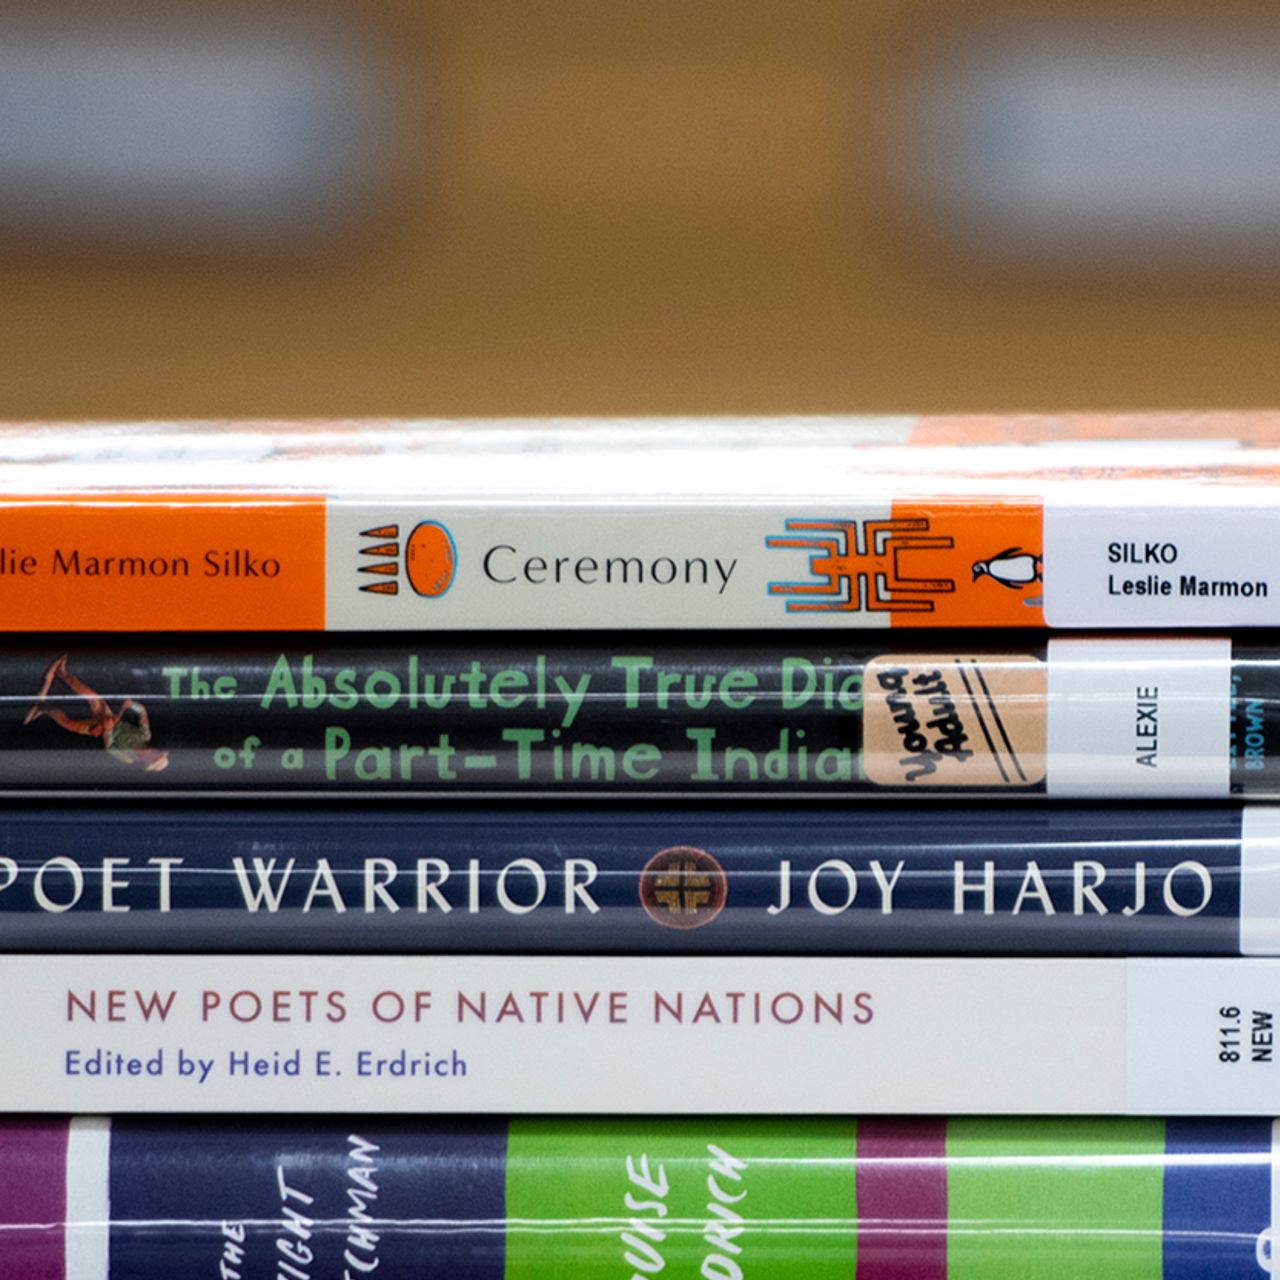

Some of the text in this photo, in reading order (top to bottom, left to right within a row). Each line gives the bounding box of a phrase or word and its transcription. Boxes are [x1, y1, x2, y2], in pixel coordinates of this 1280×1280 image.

[52, 549, 189, 577] Marmon
[203, 549, 281, 579] Silko
[483, 545, 738, 595] Ceremony
[1108, 542, 1177, 564] SILKO
[1108, 575, 1268, 599] Leslie Marmon
[162, 667, 237, 702] The
[260, 654, 590, 720] Absolutely
[611, 656, 758, 709] True
[877, 668, 943, 782] Young
[912, 669, 974, 762] Adult
[1136, 686, 1159, 768] ALEXIE
[1245, 698, 1264, 770] BROWN
[214, 734, 261, 769] of
[281, 745, 304, 770] a
[325, 727, 662, 780] Part-Time
[232, 857, 599, 914] WARRIOR
[766, 860, 1213, 918] JOY HARJO
[66, 990, 874, 1025] NEW POETS OF NATIVE NATIONS
[1220, 1005, 1241, 1063] 811.6
[1253, 1010, 1273, 1062] NEW
[65, 1051, 467, 1083] Edited by Heid E. Erdrich
